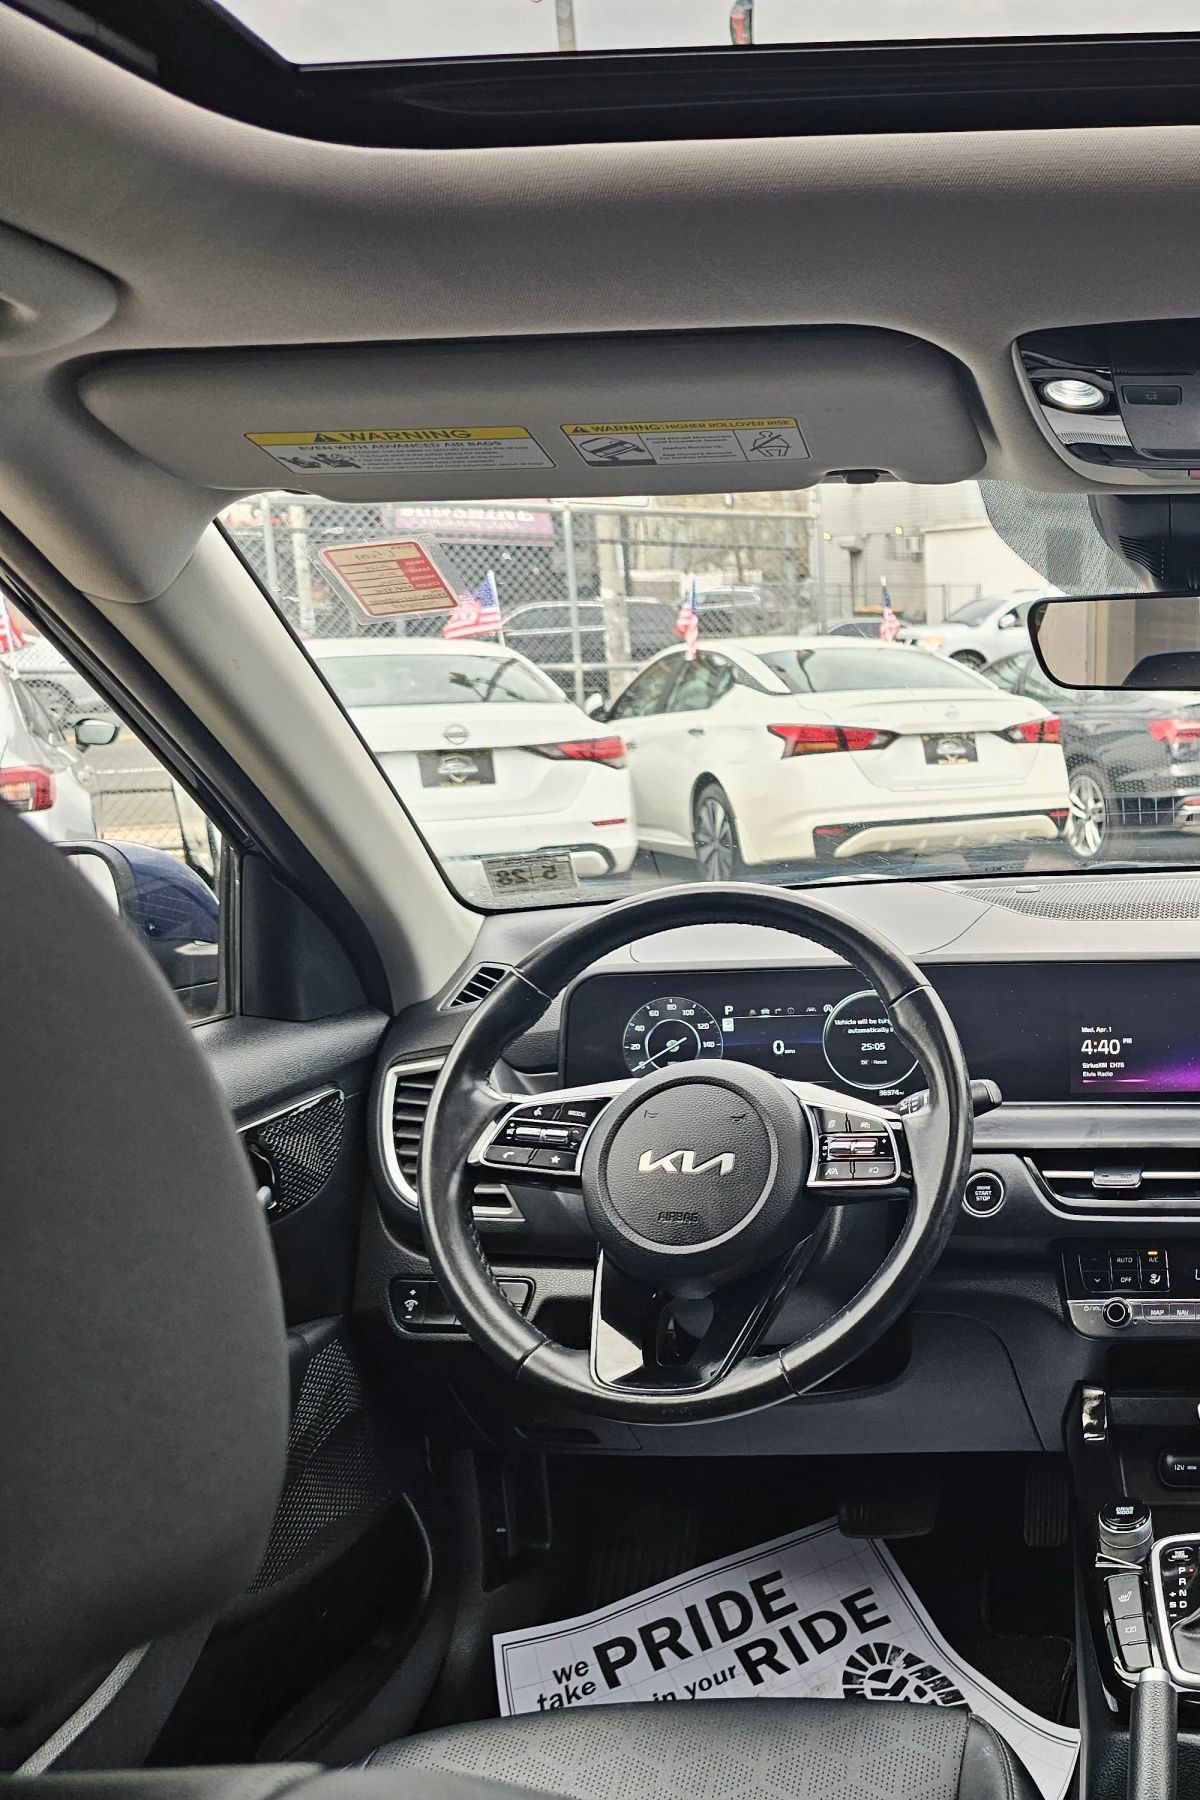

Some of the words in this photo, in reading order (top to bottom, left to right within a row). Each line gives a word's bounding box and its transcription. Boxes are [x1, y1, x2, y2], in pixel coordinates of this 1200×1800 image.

[340, 429, 472, 442] WARNING
[649, 1009, 660, 1017] 60
[724, 1005, 734, 1016] P
[847, 1026, 889, 1034] automatically
[772, 1040, 785, 1055] 0
[861, 1042, 886, 1051] 25:05
[1081, 1039, 1121, 1055] 4:40
[638, 1149, 736, 1176] KIA
[657, 1211, 699, 1222] AIRBAG
[1178, 1566, 1186, 1575] P
[1178, 1577, 1187, 1586] R
[1178, 1589, 1187, 1597] N
[1179, 1601, 1188, 1609] D
[552, 1660, 590, 1685] we
[593, 1570, 798, 1690] PRIDE
[684, 1663, 737, 1700] your
[734, 1587, 892, 1686] RIDE
[536, 1678, 597, 1711] take
